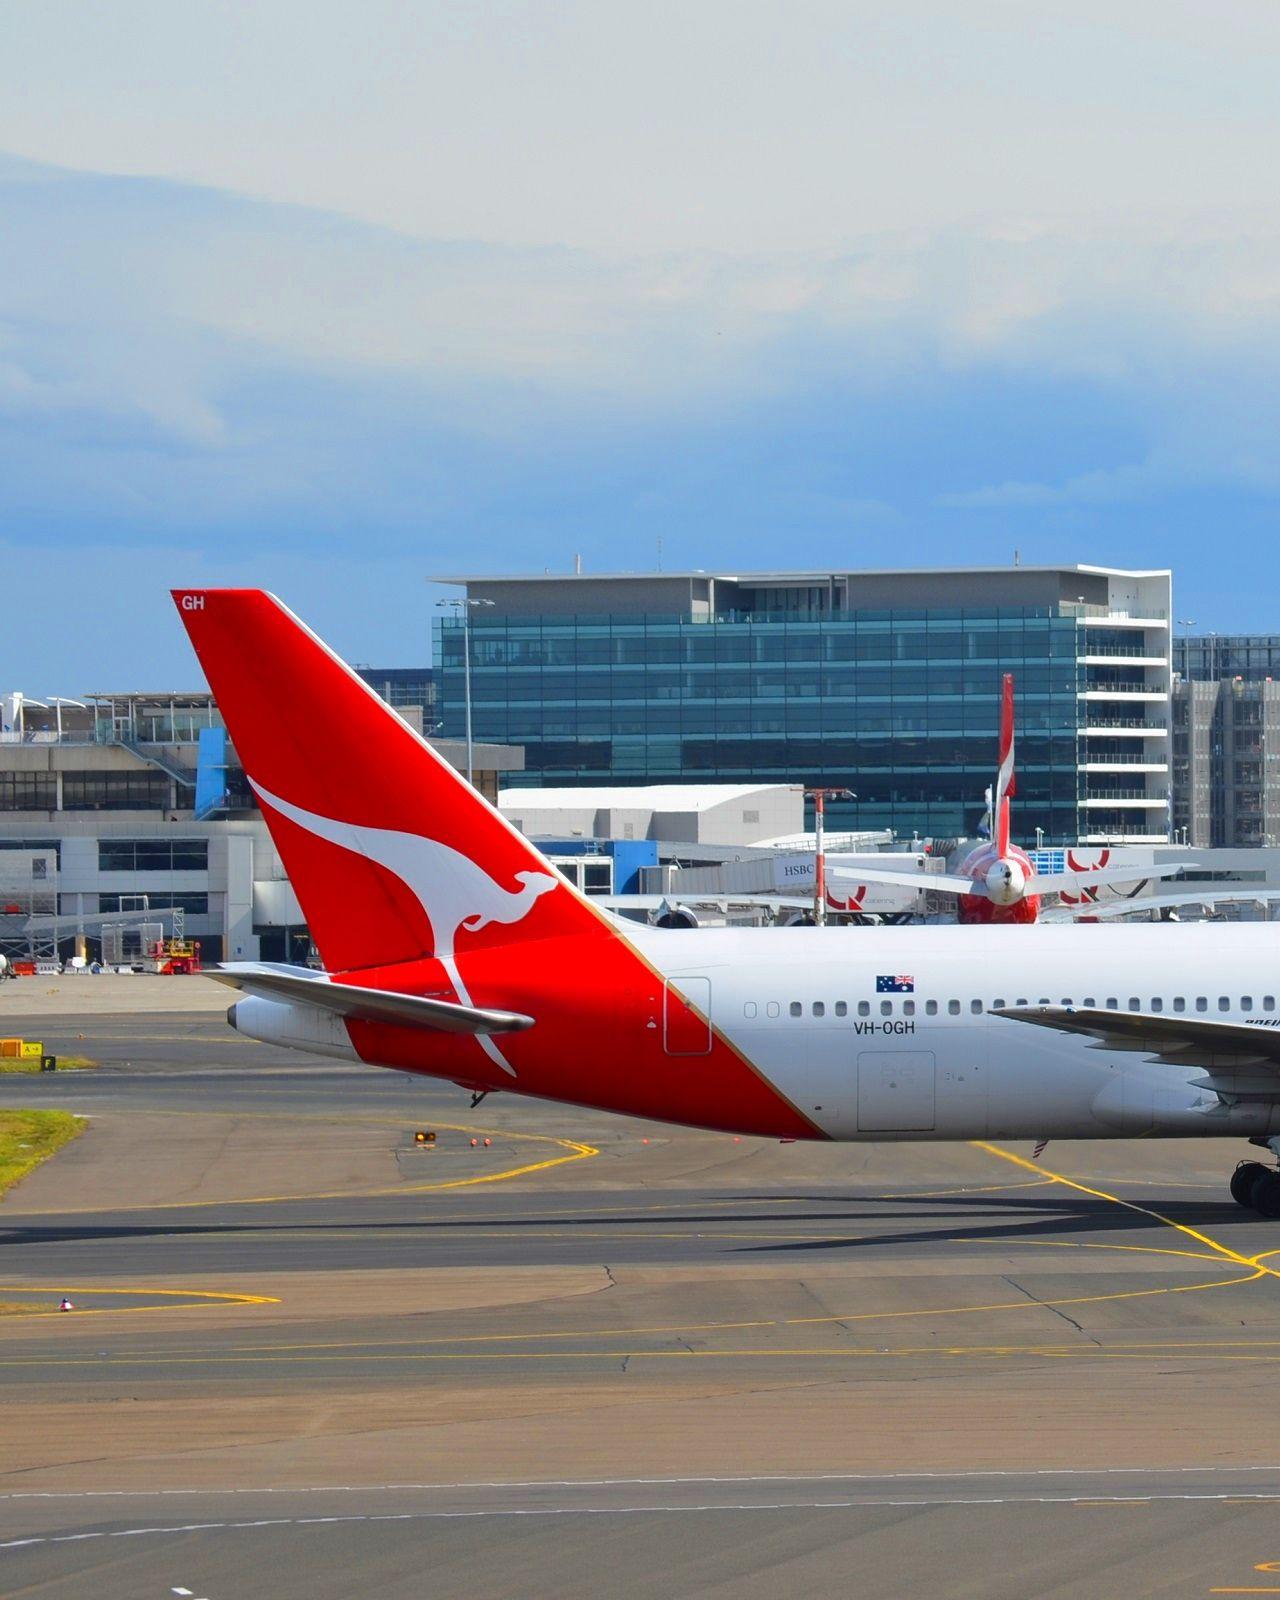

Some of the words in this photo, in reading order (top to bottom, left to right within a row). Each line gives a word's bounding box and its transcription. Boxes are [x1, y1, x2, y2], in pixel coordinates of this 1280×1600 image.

[181, 595, 205, 610] GH
[784, 864, 815, 876] HSBC
[854, 1021, 915, 1035] VH-OGH
